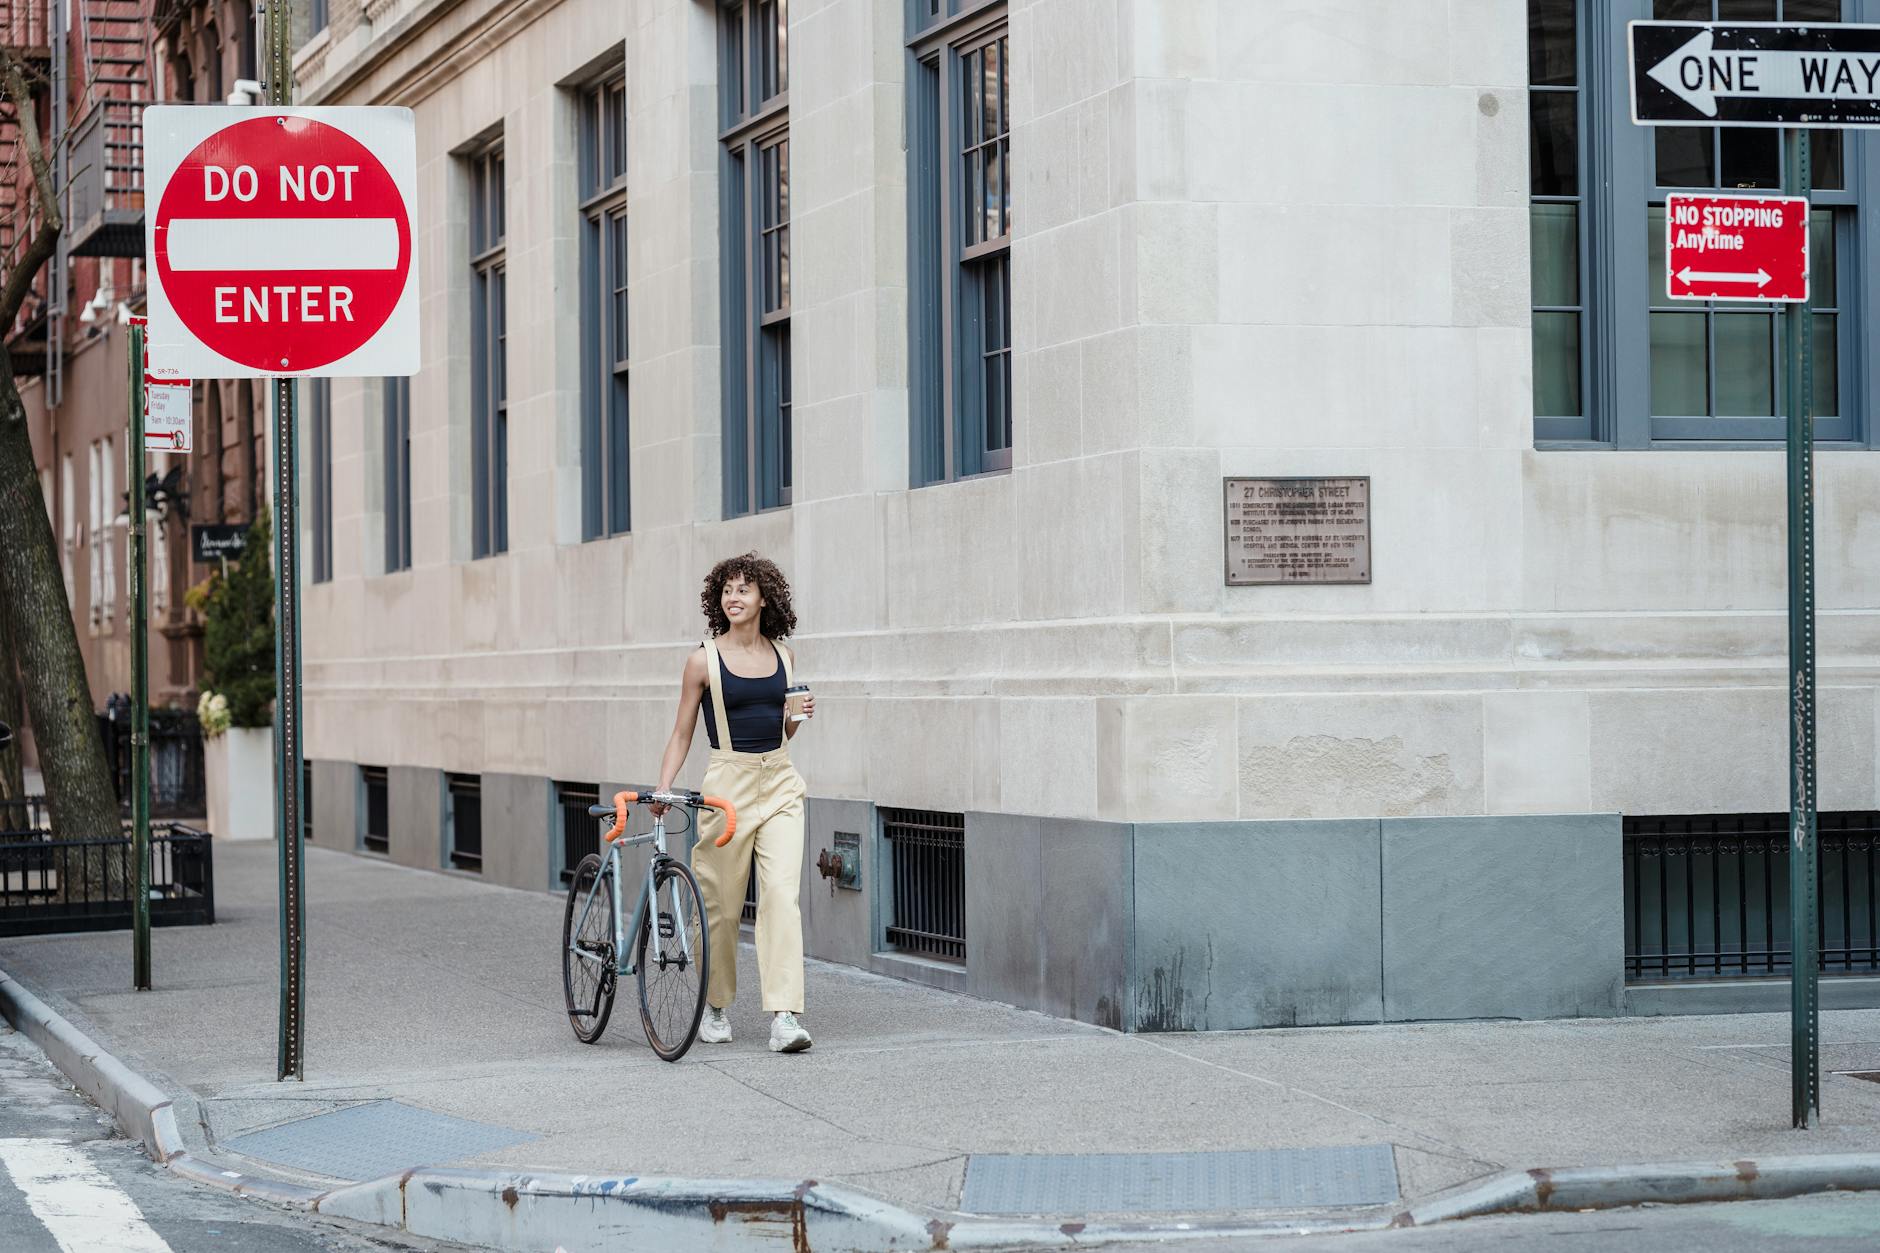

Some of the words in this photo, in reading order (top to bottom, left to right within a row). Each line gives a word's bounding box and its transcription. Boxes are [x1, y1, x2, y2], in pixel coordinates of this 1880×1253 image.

[1680, 56, 1760, 92] ONE
[1800, 57, 1880, 94] WAY
[204, 165, 258, 202] DO
[279, 165, 359, 202] NOT
[1675, 206, 1699, 225] NO
[1703, 208, 1783, 228] STOPPING
[1676, 229, 1744, 253] Anytime
[215, 286, 354, 323] ENTER
[151, 390, 170, 400] Tuesday
[151, 401, 165, 411] Friday
[1244, 487, 1254, 498] 27
[1259, 487, 1314, 498] CHRISTOPHER
[1319, 487, 1350, 497] STREET
